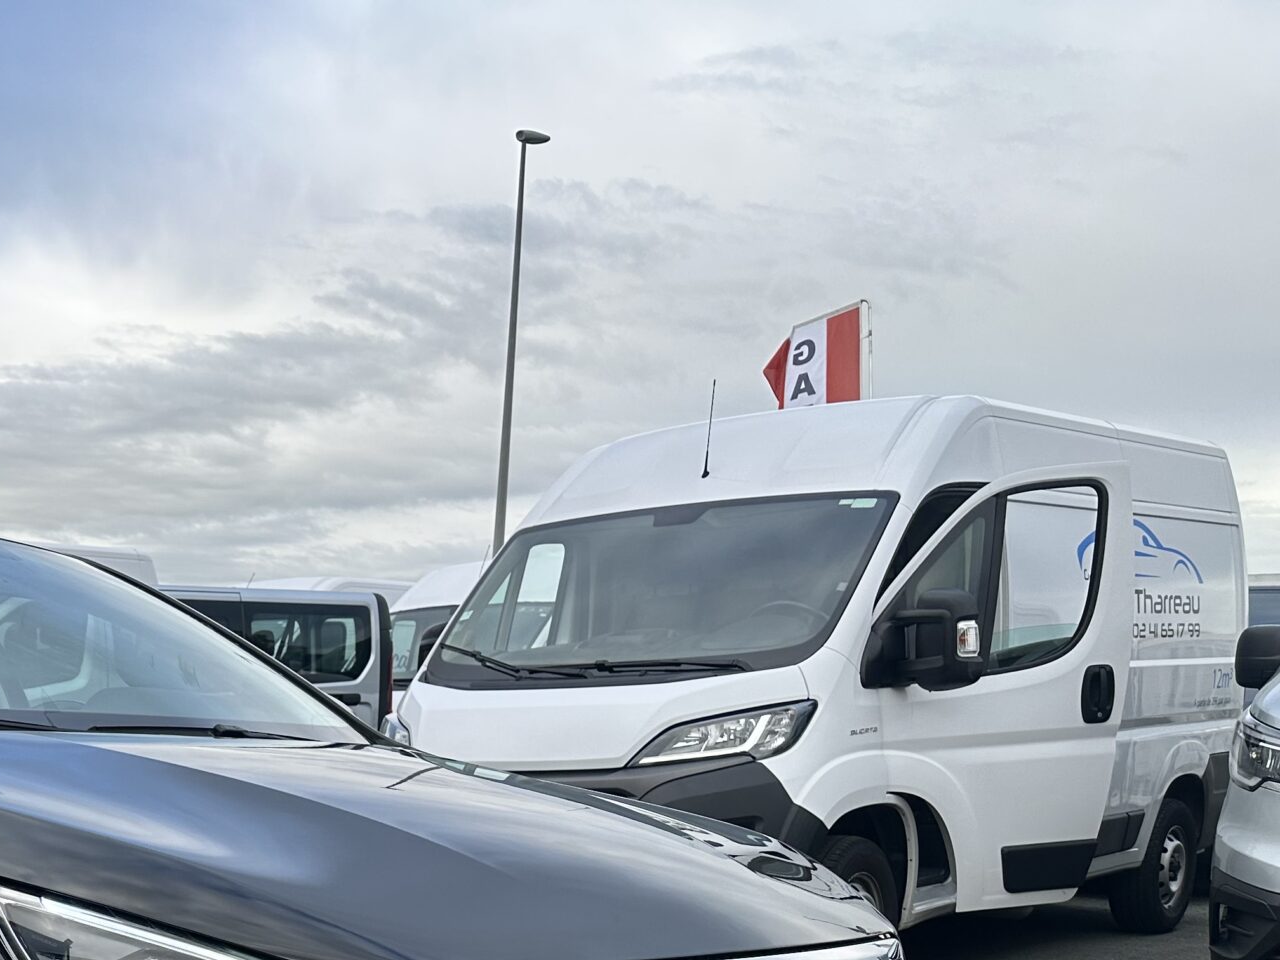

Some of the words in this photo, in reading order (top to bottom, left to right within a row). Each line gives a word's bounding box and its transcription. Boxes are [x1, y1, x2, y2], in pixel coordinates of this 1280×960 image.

[1134, 588, 1201, 614] Tharreau
[1132, 622, 1147, 639] 02
[1148, 622, 1159, 639] 41
[1160, 622, 1175, 638] 65
[1176, 622, 1186, 638] 17
[1187, 622, 1201, 638] 99
